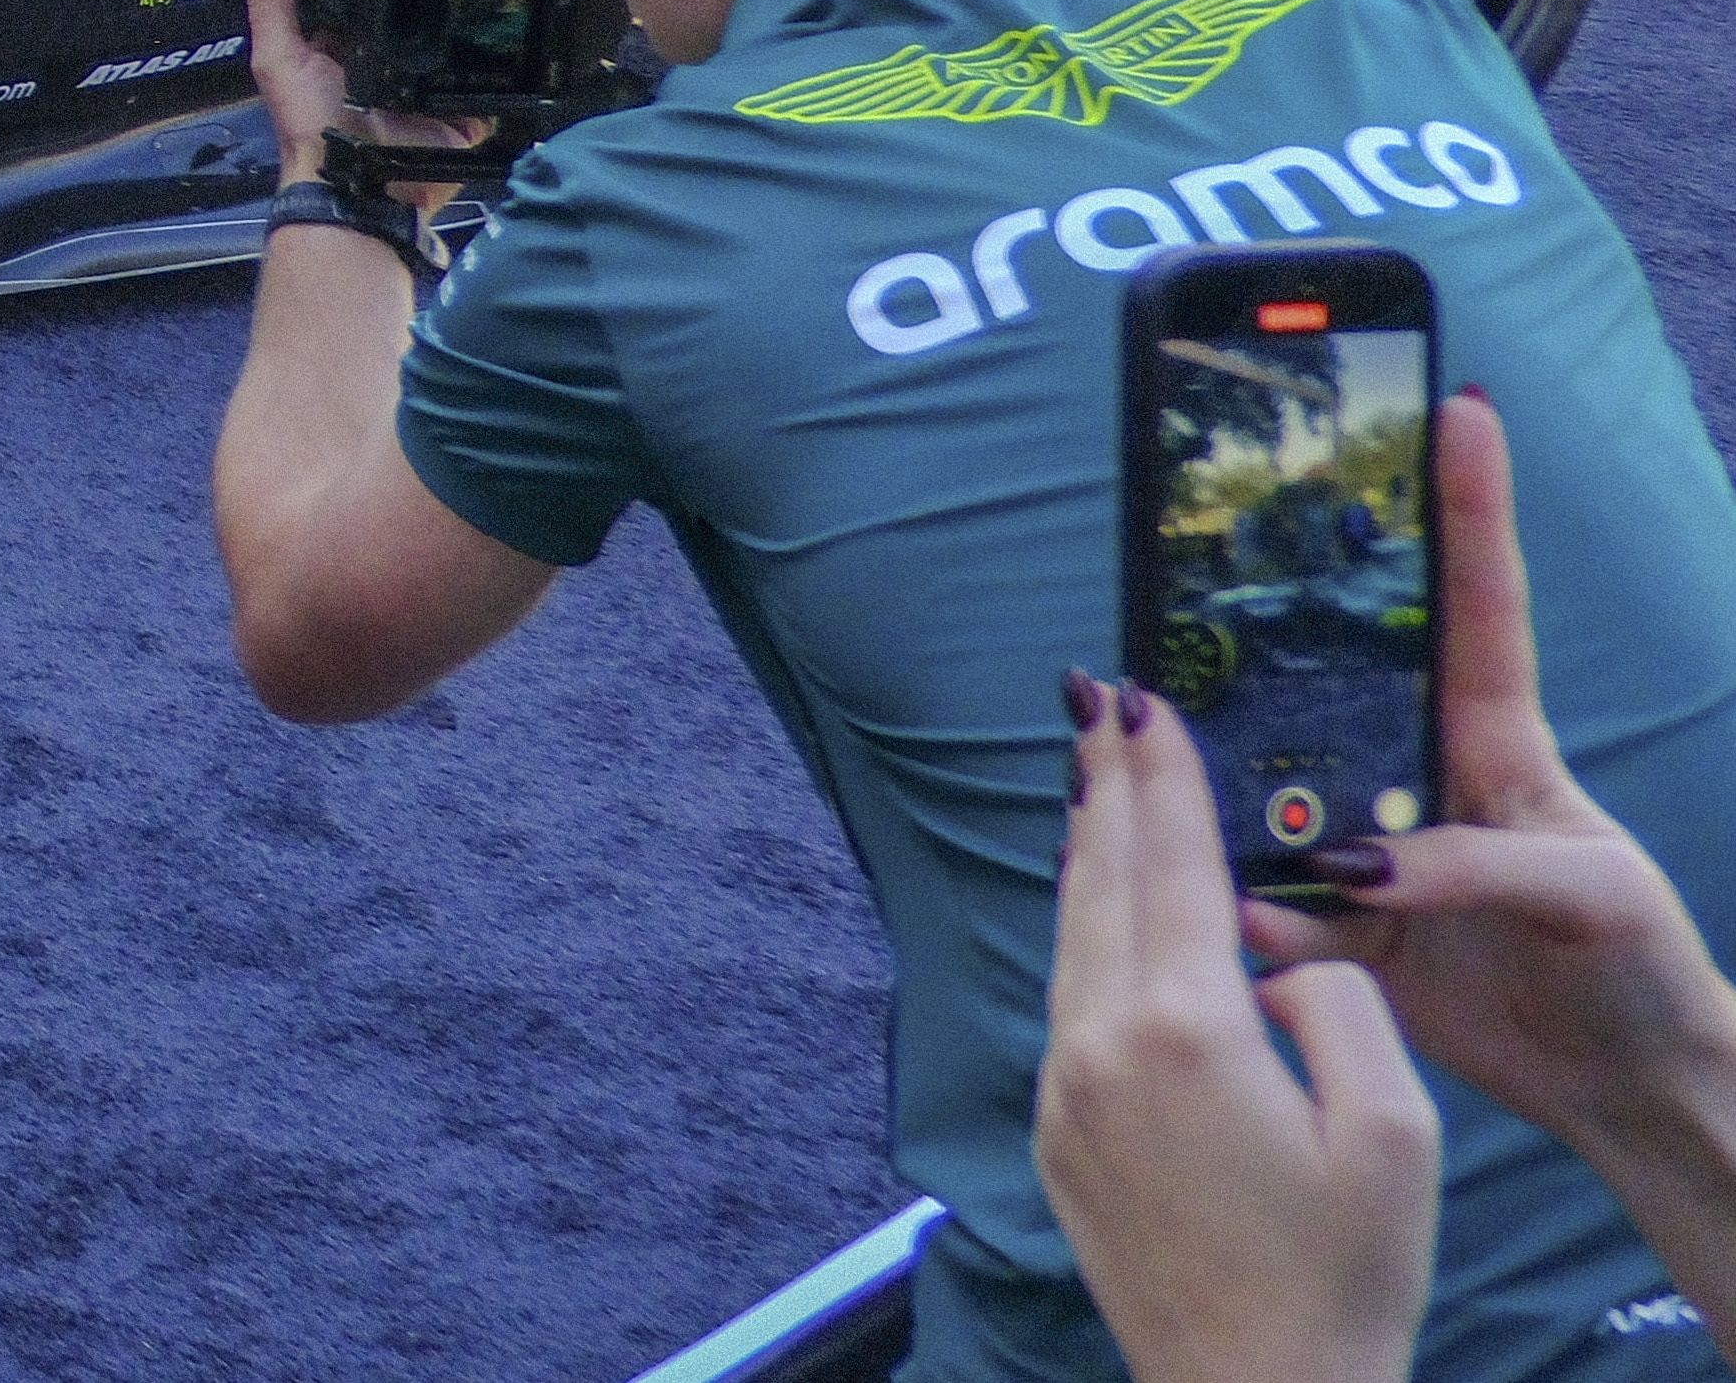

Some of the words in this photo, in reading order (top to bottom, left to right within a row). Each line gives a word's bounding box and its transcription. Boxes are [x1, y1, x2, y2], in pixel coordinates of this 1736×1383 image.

[76, 50, 189, 89] ATLAS
[184, 35, 245, 66] AIR
[845, 119, 1524, 356] aramco
